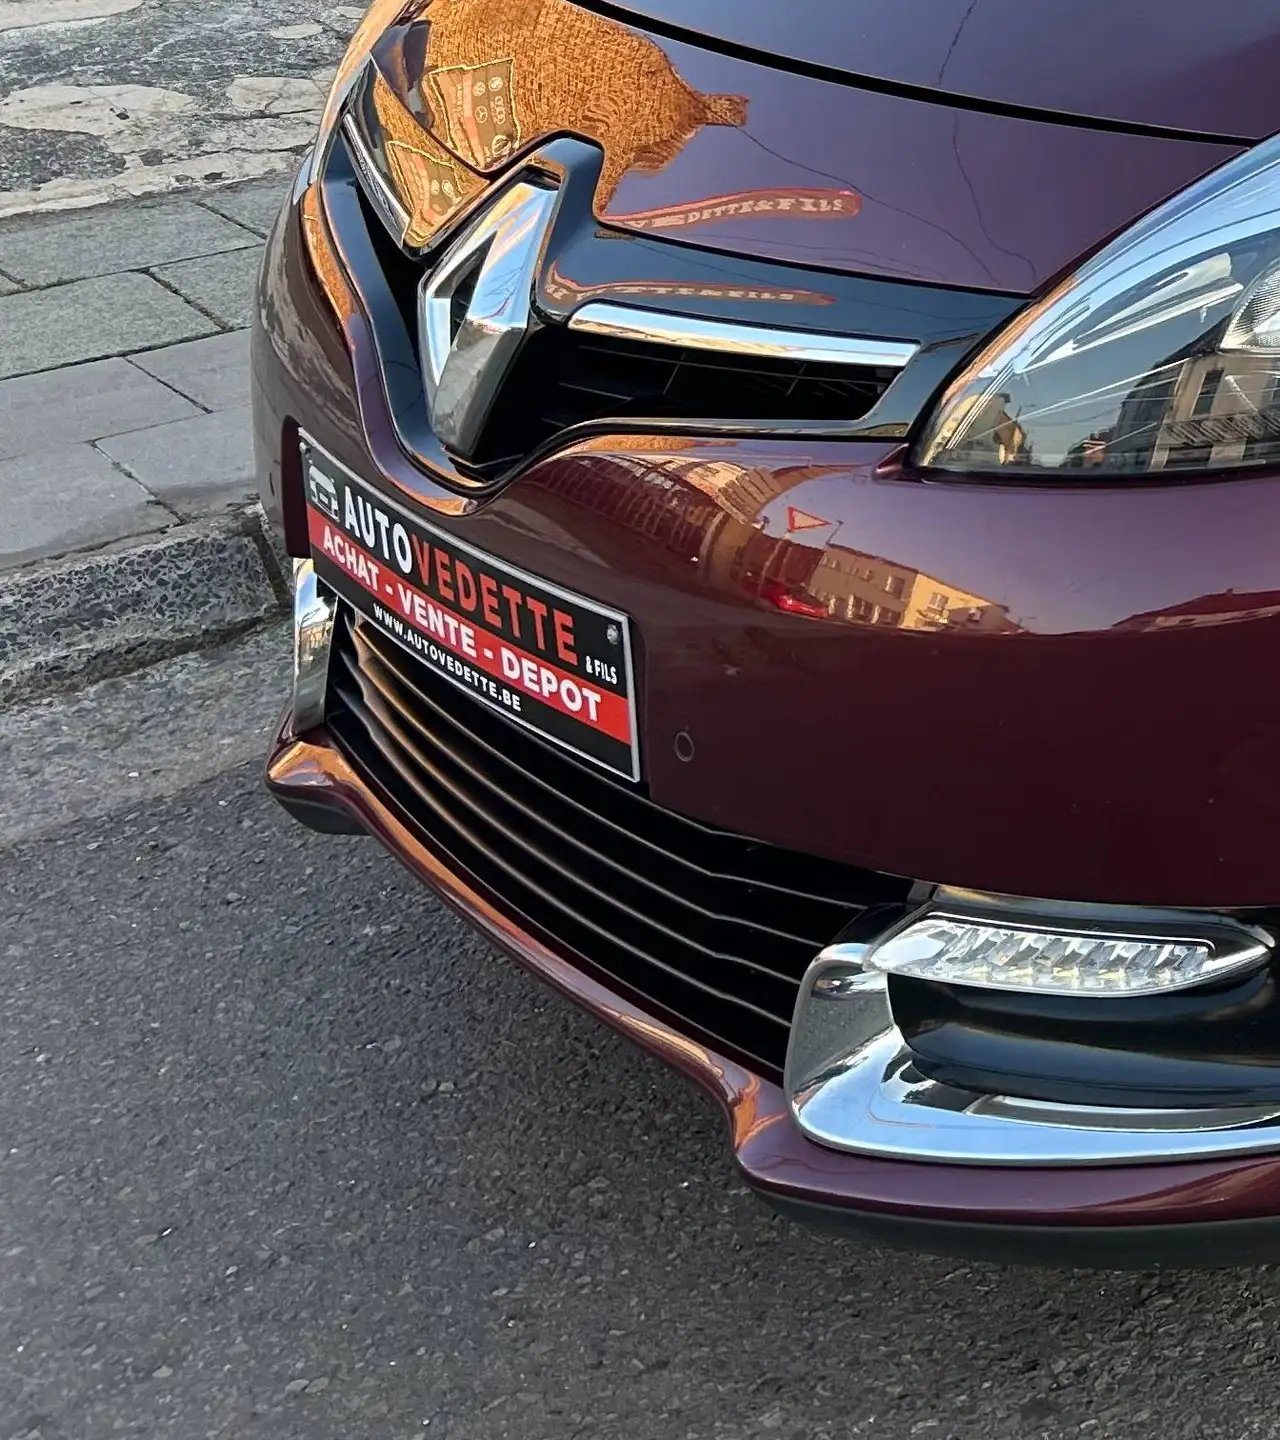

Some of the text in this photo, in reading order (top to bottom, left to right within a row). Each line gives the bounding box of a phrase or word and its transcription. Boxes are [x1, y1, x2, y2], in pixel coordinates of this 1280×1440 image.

[323, 526, 380, 591] ACHAT
[398, 583, 477, 658] VENTE
[501, 648, 602, 722] DEPOT
[344, 486, 579, 666] AUTOVEDETTE
[372, 602, 522, 712] WWW.AUTOVEDETTE.BE
[594, 658, 619, 685] FILS
